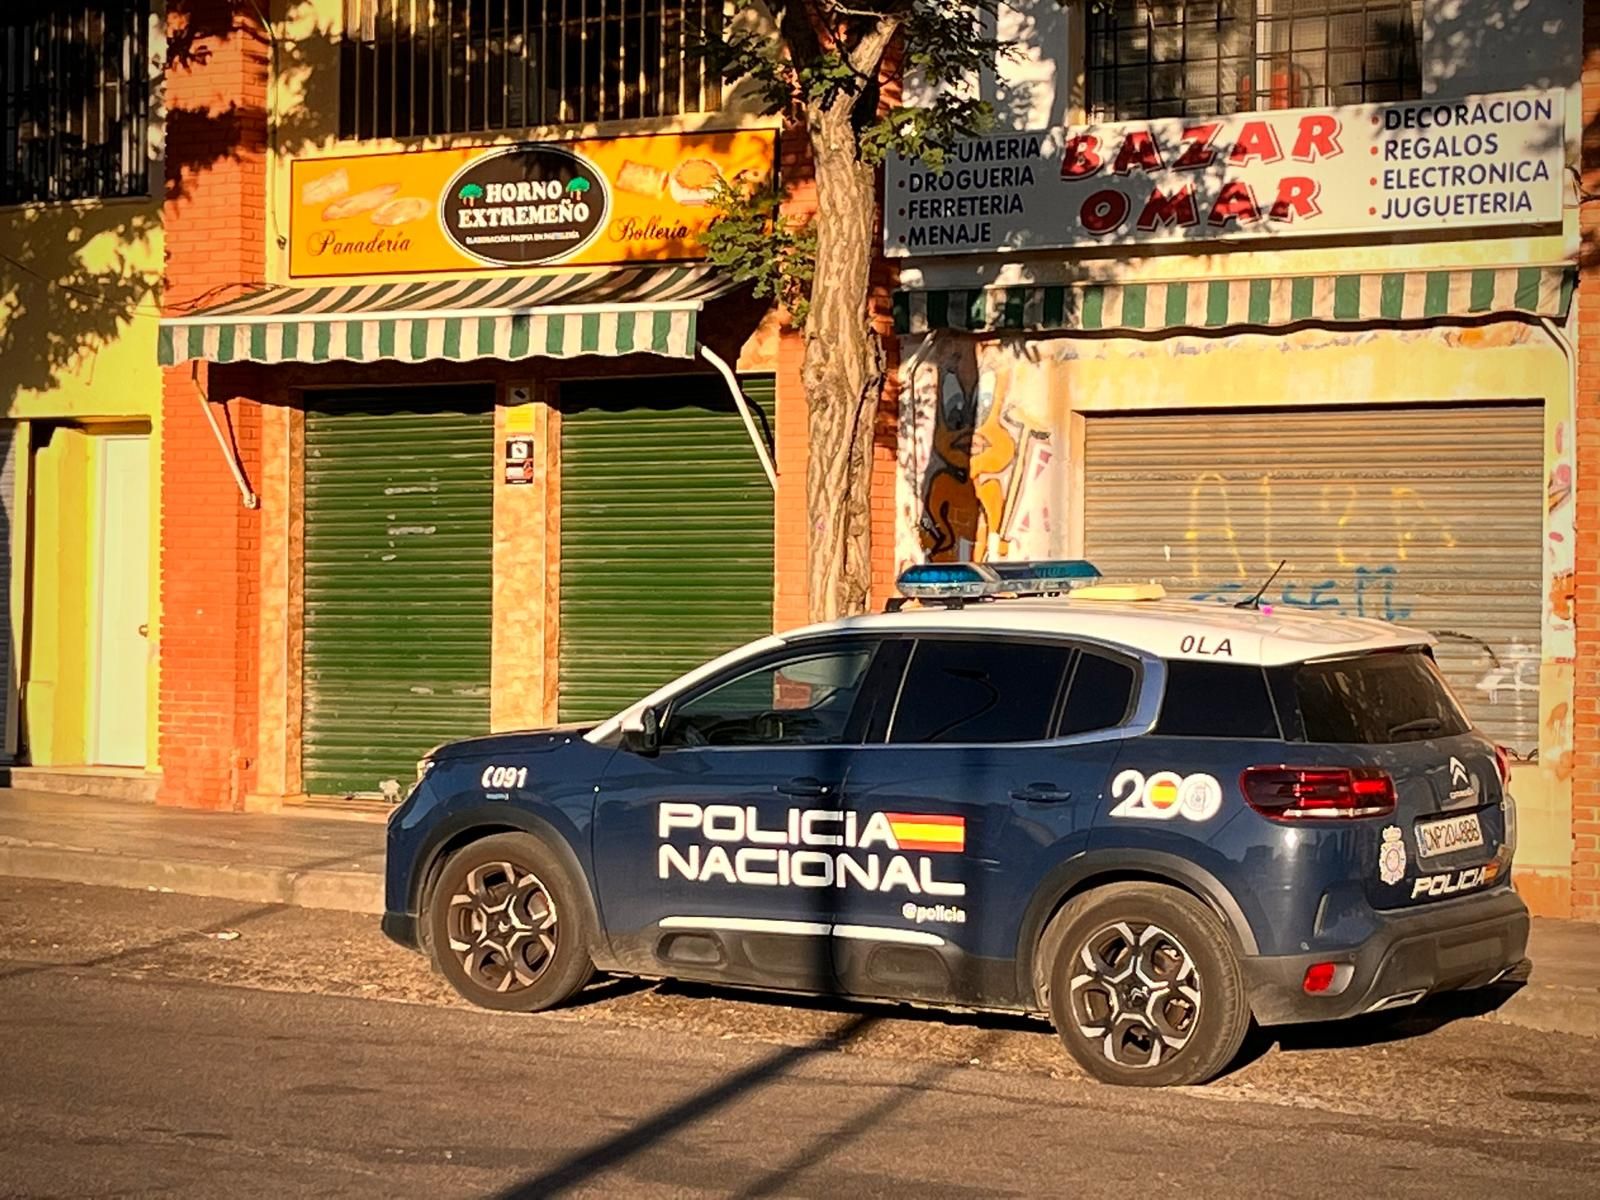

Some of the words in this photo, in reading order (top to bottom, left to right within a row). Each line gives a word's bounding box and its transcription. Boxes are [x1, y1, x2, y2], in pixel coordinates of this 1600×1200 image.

[1385, 99, 1553, 132] DECORACION
[908, 136, 1042, 167] FUMERIA
[1060, 116, 1343, 182] BAZAR
[1384, 132, 1499, 162] REGALOS
[909, 165, 1034, 193] DROGUERIA
[1383, 160, 1550, 191] ELECTRONICA
[485, 180, 563, 204] HORNO
[907, 193, 1024, 221] FERRETERIA
[1079, 176, 1323, 236] OMAR
[1381, 190, 1533, 220] JUGUETERIA
[457, 198, 590, 229] EXTREMEÑO
[306, 228, 412, 257] Panadería
[908, 222, 992, 247] MENAJE
[1108, 769, 1223, 822] 200
[658, 802, 900, 850] POLICIA
[658, 844, 966, 896] NACIONAL
[1410, 867, 1487, 900] POLICIA
[901, 902, 967, 924] @policia
